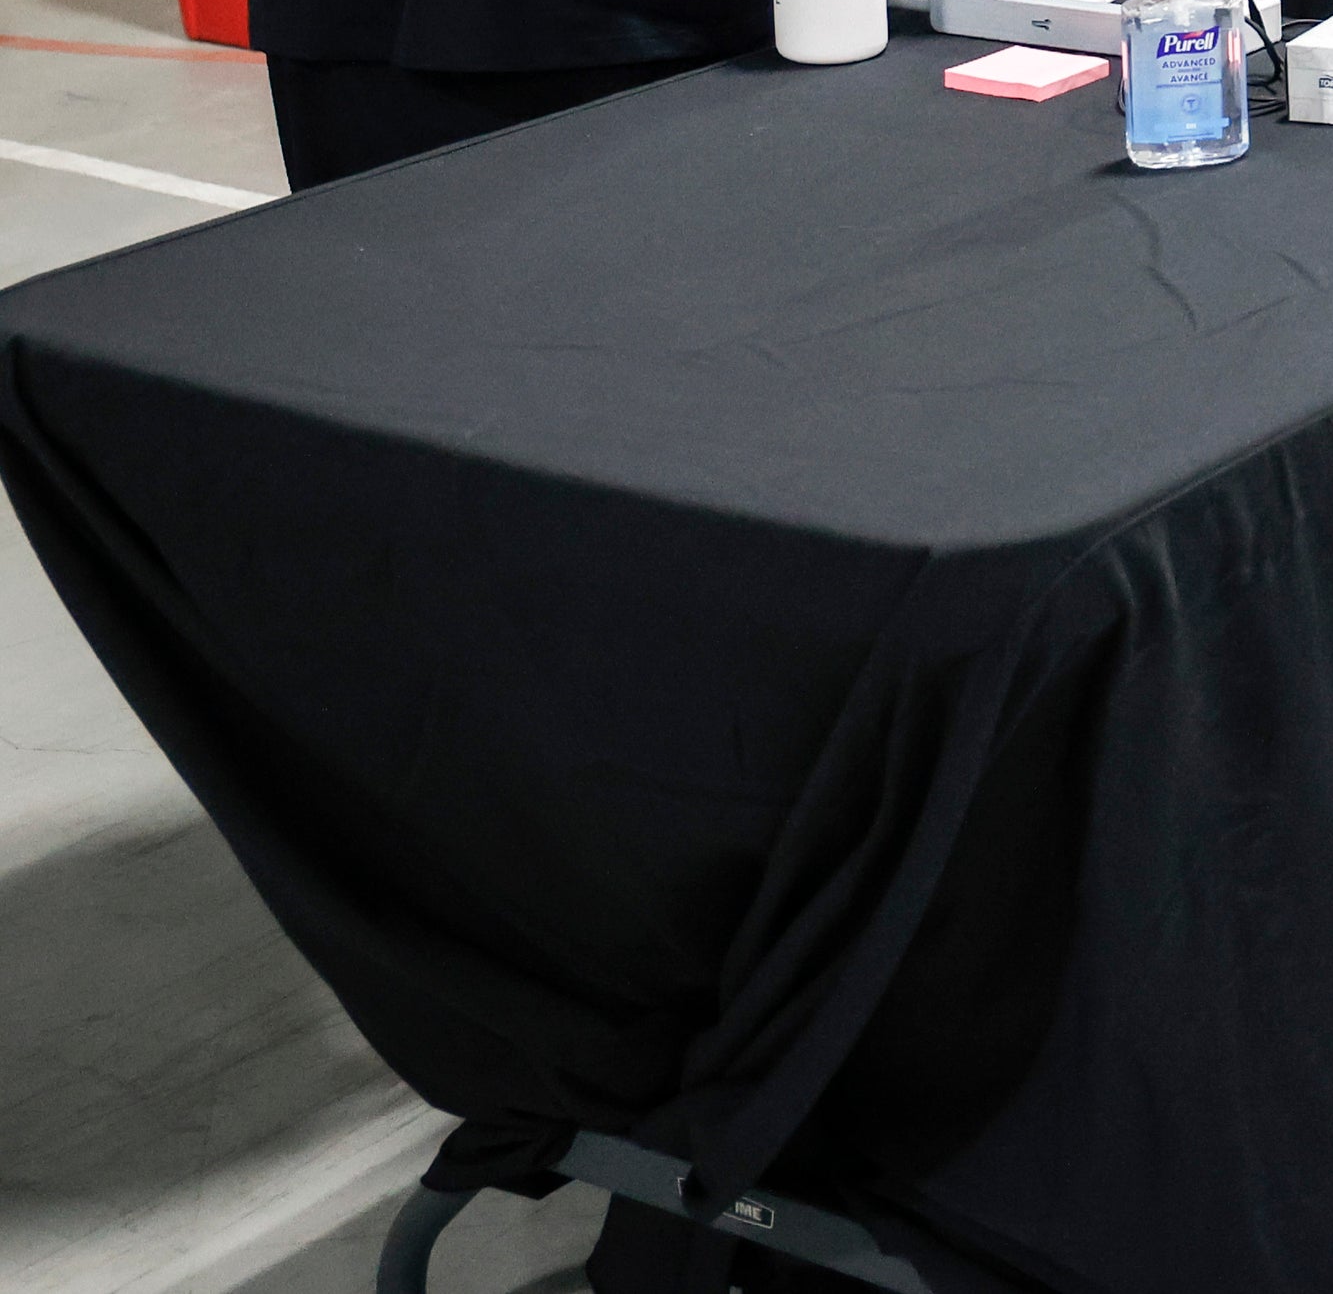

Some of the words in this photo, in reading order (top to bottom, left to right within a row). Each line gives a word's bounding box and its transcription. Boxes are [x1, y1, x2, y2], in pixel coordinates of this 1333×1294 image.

[1163, 31, 1216, 54] Purell
[1162, 57, 1216, 69] ADVANCED
[735, 1202, 762, 1221] IME
